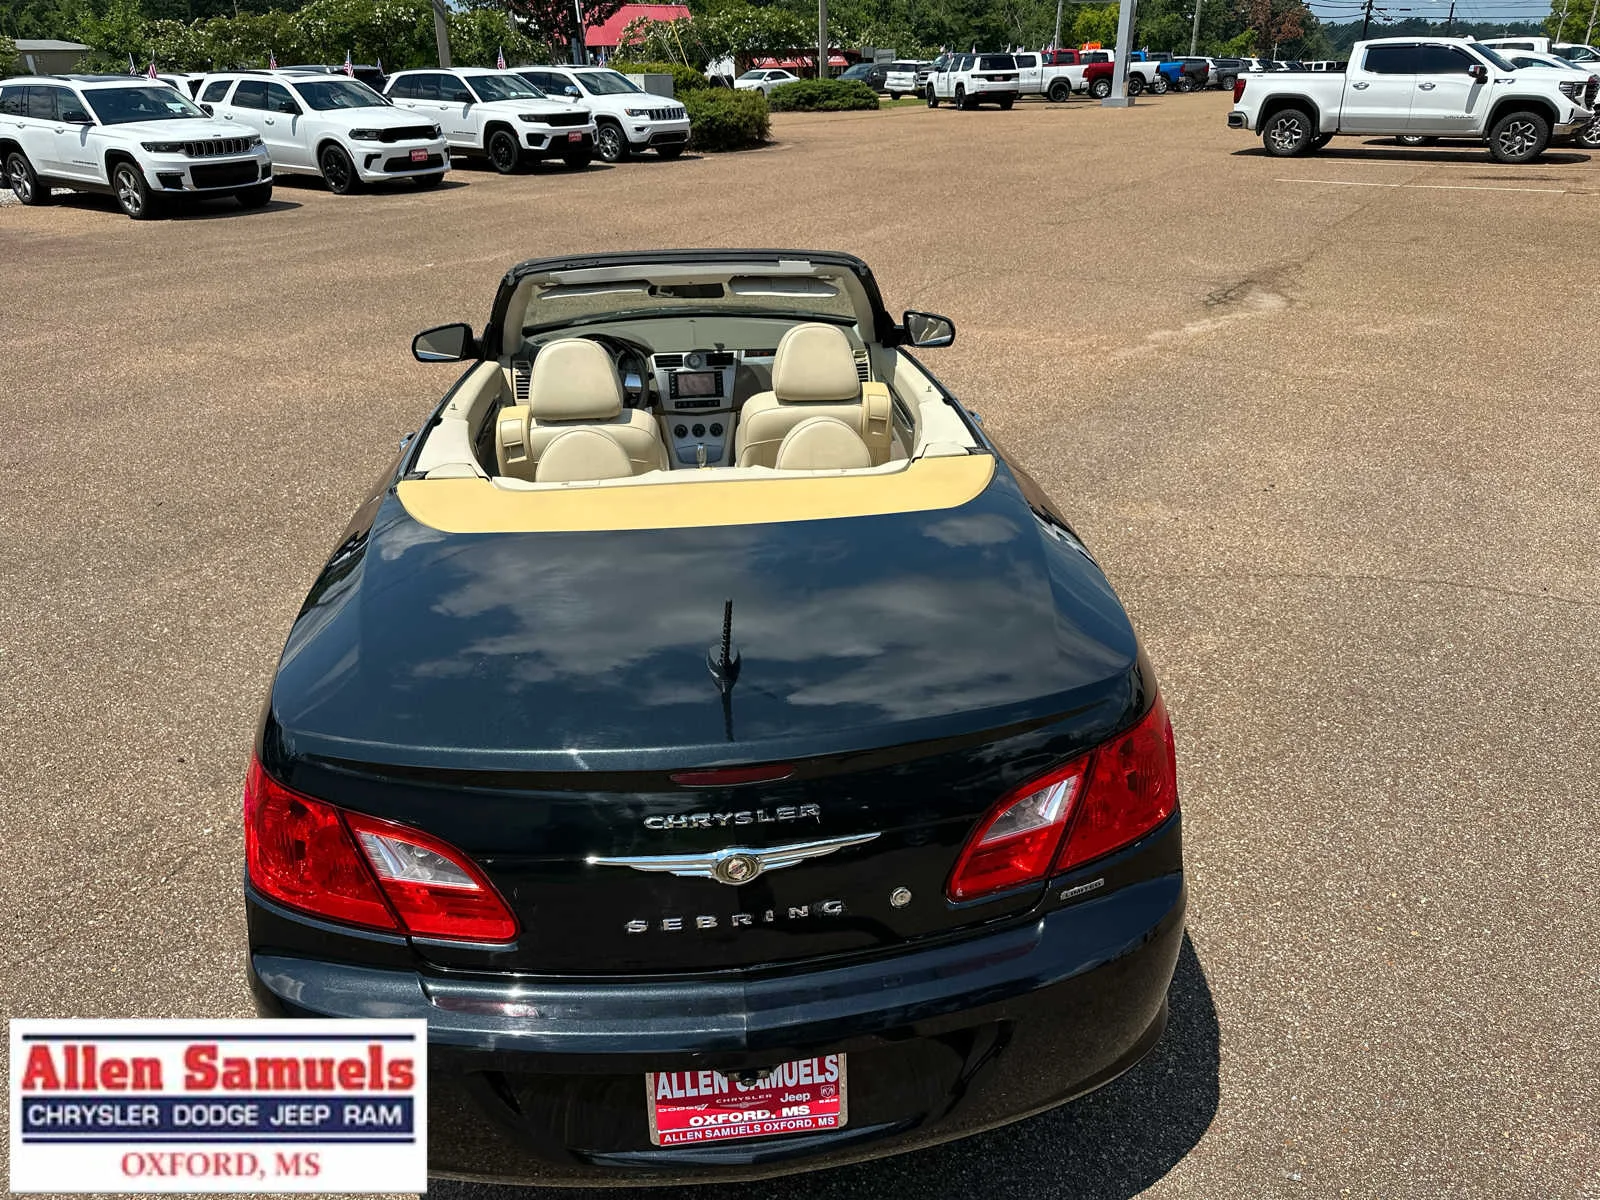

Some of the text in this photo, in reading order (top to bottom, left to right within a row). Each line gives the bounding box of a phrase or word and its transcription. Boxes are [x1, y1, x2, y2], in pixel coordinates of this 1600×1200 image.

[643, 803, 821, 830] CHRYSLER
[1065, 879, 1103, 898] LIMITED
[625, 899, 846, 934] SEBRING
[656, 1070, 729, 1100] ALLEN
[715, 1094, 772, 1104] CHRYSLER
[780, 1092, 811, 1103] Jeep
[689, 1105, 811, 1127] OXFORD, MS
[663, 1117, 835, 1144] ALLEN SAMUELS OXFORD, MS
